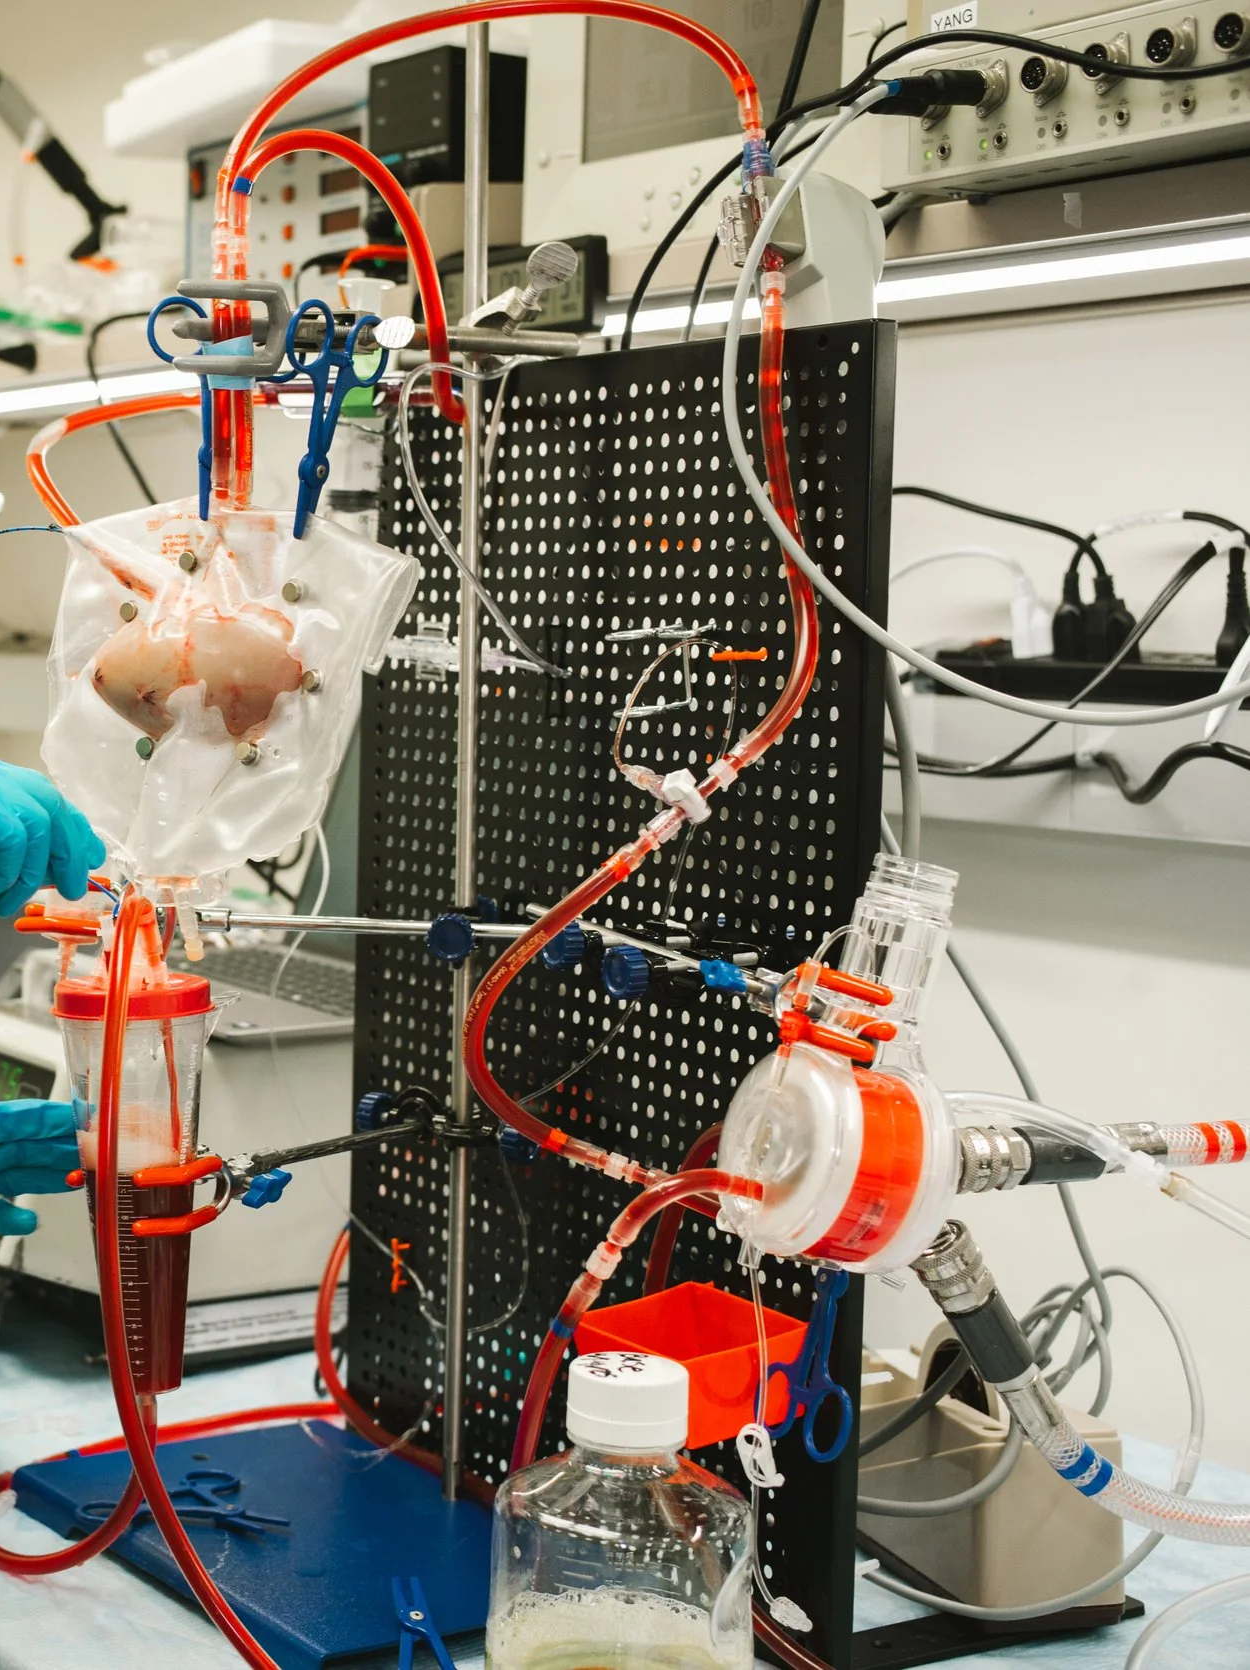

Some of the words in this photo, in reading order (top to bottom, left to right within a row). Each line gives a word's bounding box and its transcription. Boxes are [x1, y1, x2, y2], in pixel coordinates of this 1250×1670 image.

[934, 9, 973, 31] YANG
[182, 1100, 192, 1136] Critical
[179, 1138, 188, 1167] Meas
